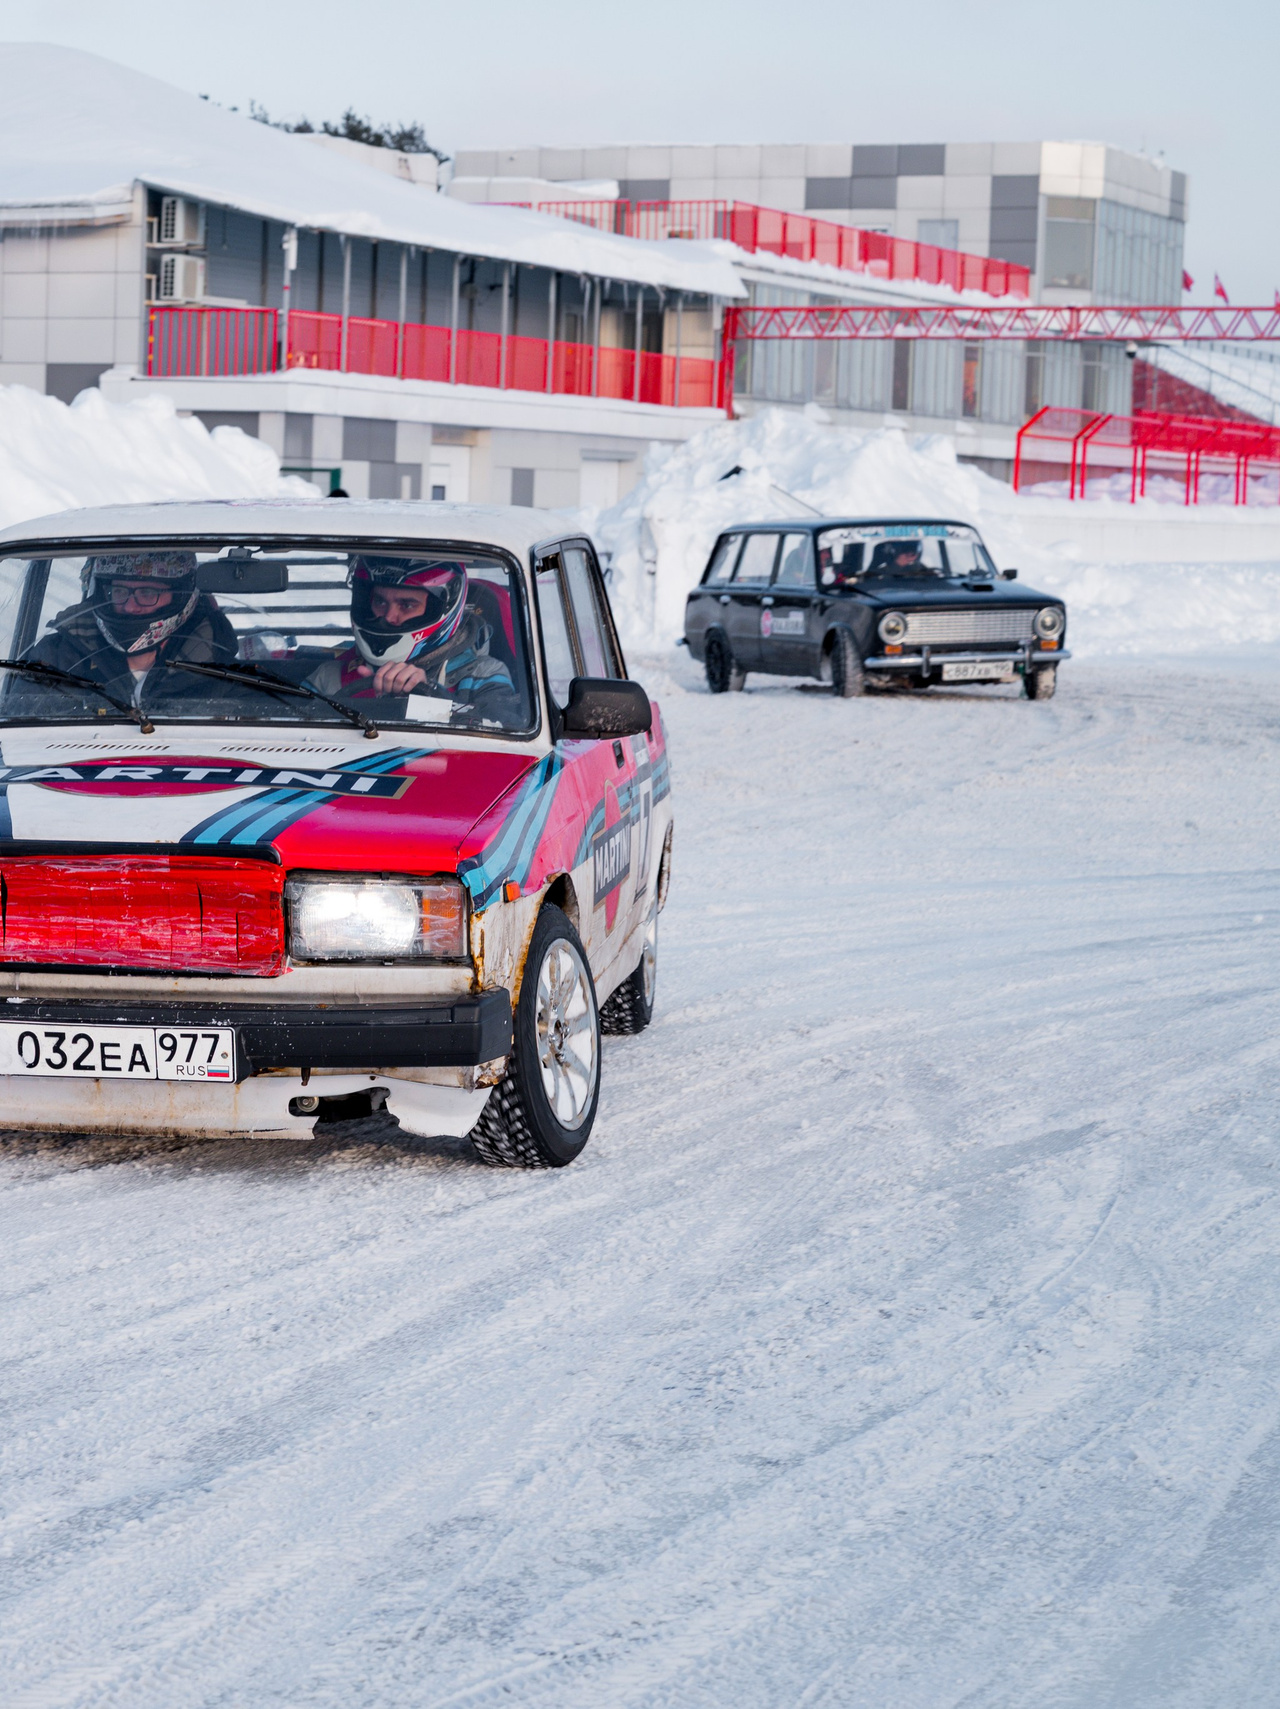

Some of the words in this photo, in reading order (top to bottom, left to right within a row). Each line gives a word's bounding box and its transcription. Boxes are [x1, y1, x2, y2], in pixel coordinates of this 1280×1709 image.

[596, 823, 630, 893] MARTINI
[158, 1033, 220, 1063] 977
[176, 1064, 206, 1077] RUS
